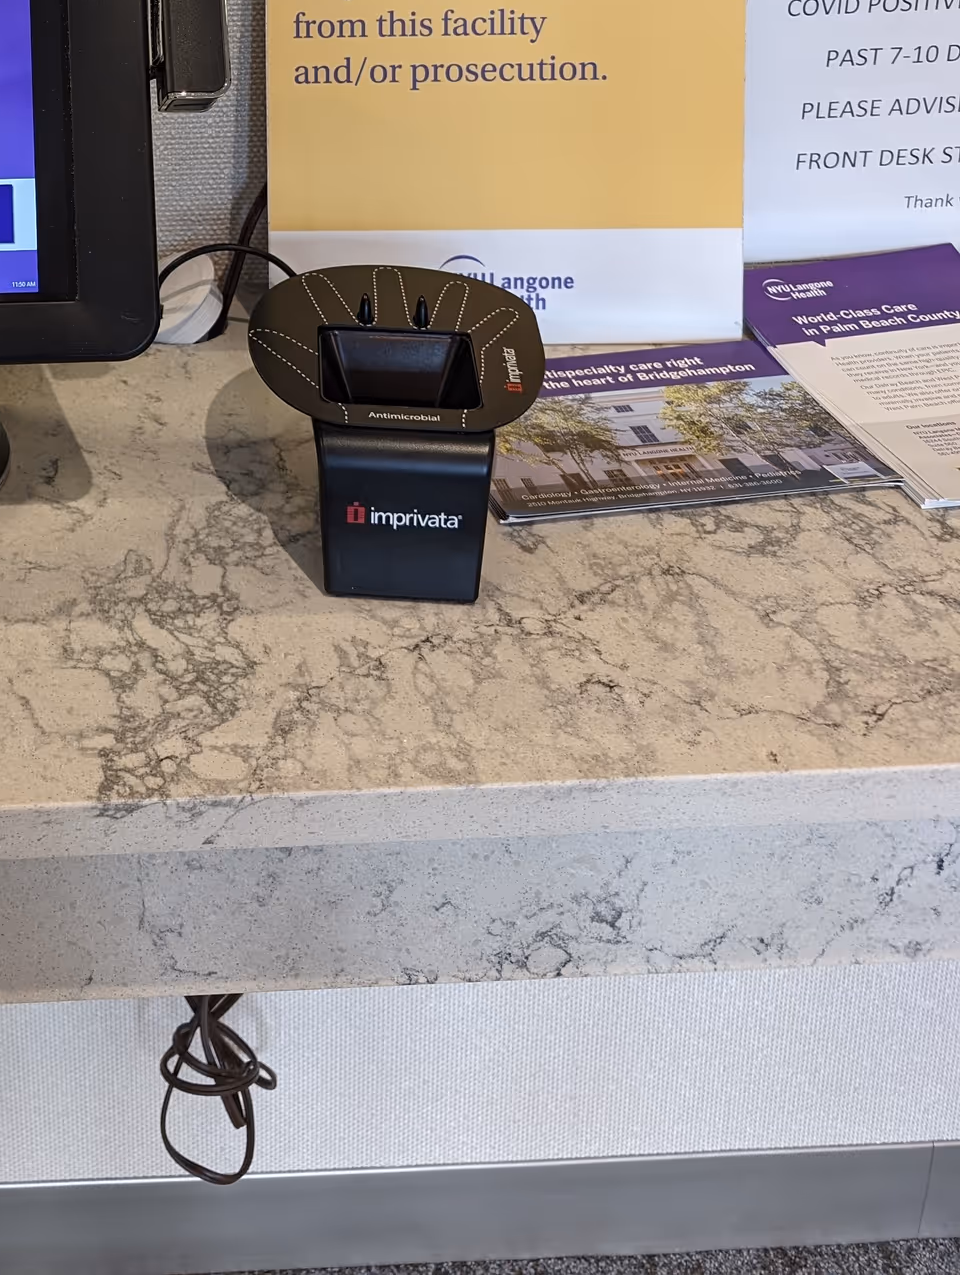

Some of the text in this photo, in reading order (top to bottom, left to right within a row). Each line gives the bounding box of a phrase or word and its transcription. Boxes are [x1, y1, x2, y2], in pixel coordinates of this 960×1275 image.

[293, 9, 547, 44] from this facility
[826, 47, 883, 68] PAST
[890, 44, 940, 65] 7-10
[293, 56, 607, 91] and/or prosecution.
[801, 96, 960, 120] PLEASE ADVIS
[795, 150, 872, 171] FRONT
[879, 147, 935, 167] DESK
[904, 193, 954, 209] Thank
[767, 279, 834, 295] NYU Langone
[791, 289, 828, 300] Health
[792, 302, 919, 325] World-Class Care
[802, 308, 960, 337] in Palm Beach County
[629, 361, 663, 371] care
[665, 356, 704, 369] right
[543, 363, 756, 390] the heart of Bridgehampton
[368, 410, 441, 423] Antimicrobial
[521, 469, 802, 501] Cardiology Gastroenterology Internal Medicine Pediatrics
